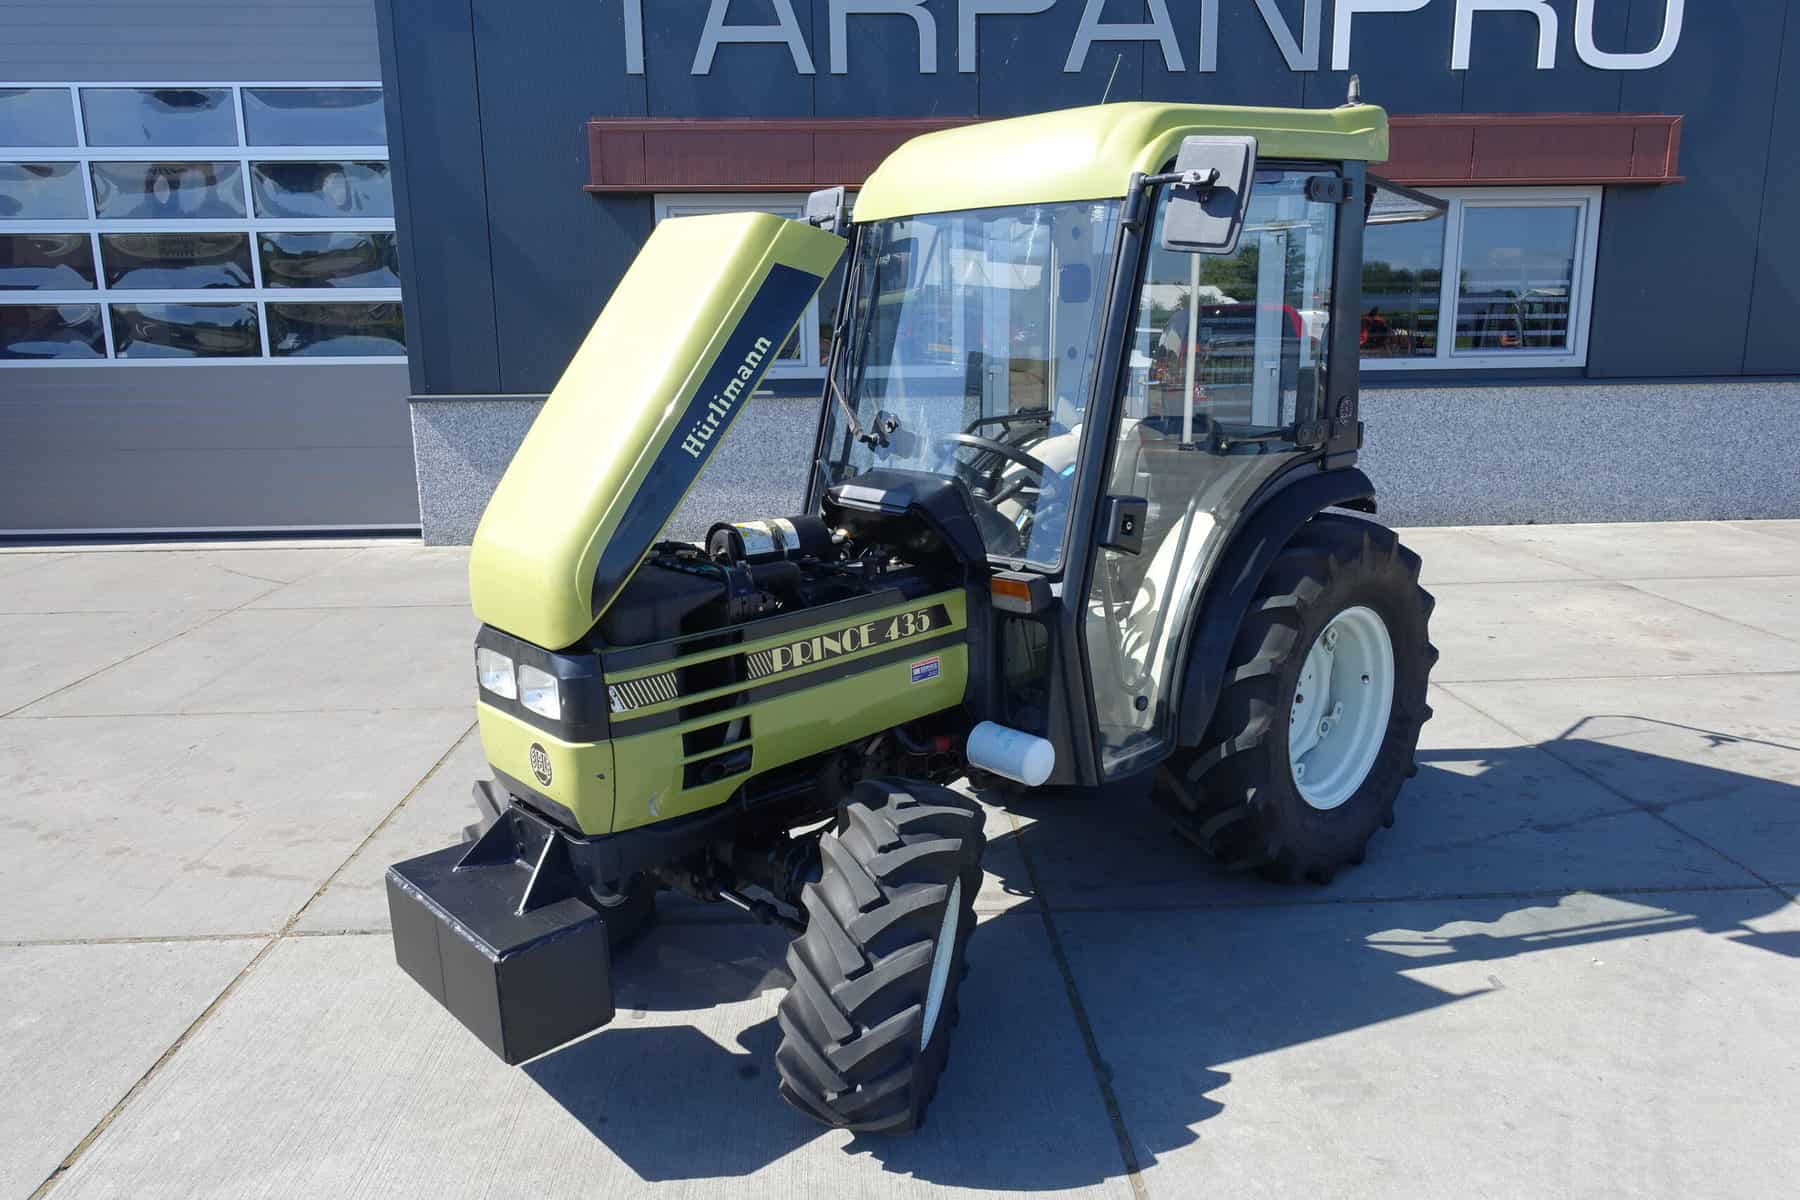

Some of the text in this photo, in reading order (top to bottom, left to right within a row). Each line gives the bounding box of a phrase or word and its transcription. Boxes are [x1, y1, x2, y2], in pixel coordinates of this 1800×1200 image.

[681, 336, 773, 459] Hürlimann
[771, 622, 878, 673] PRINCE
[884, 608, 931, 641] 435
